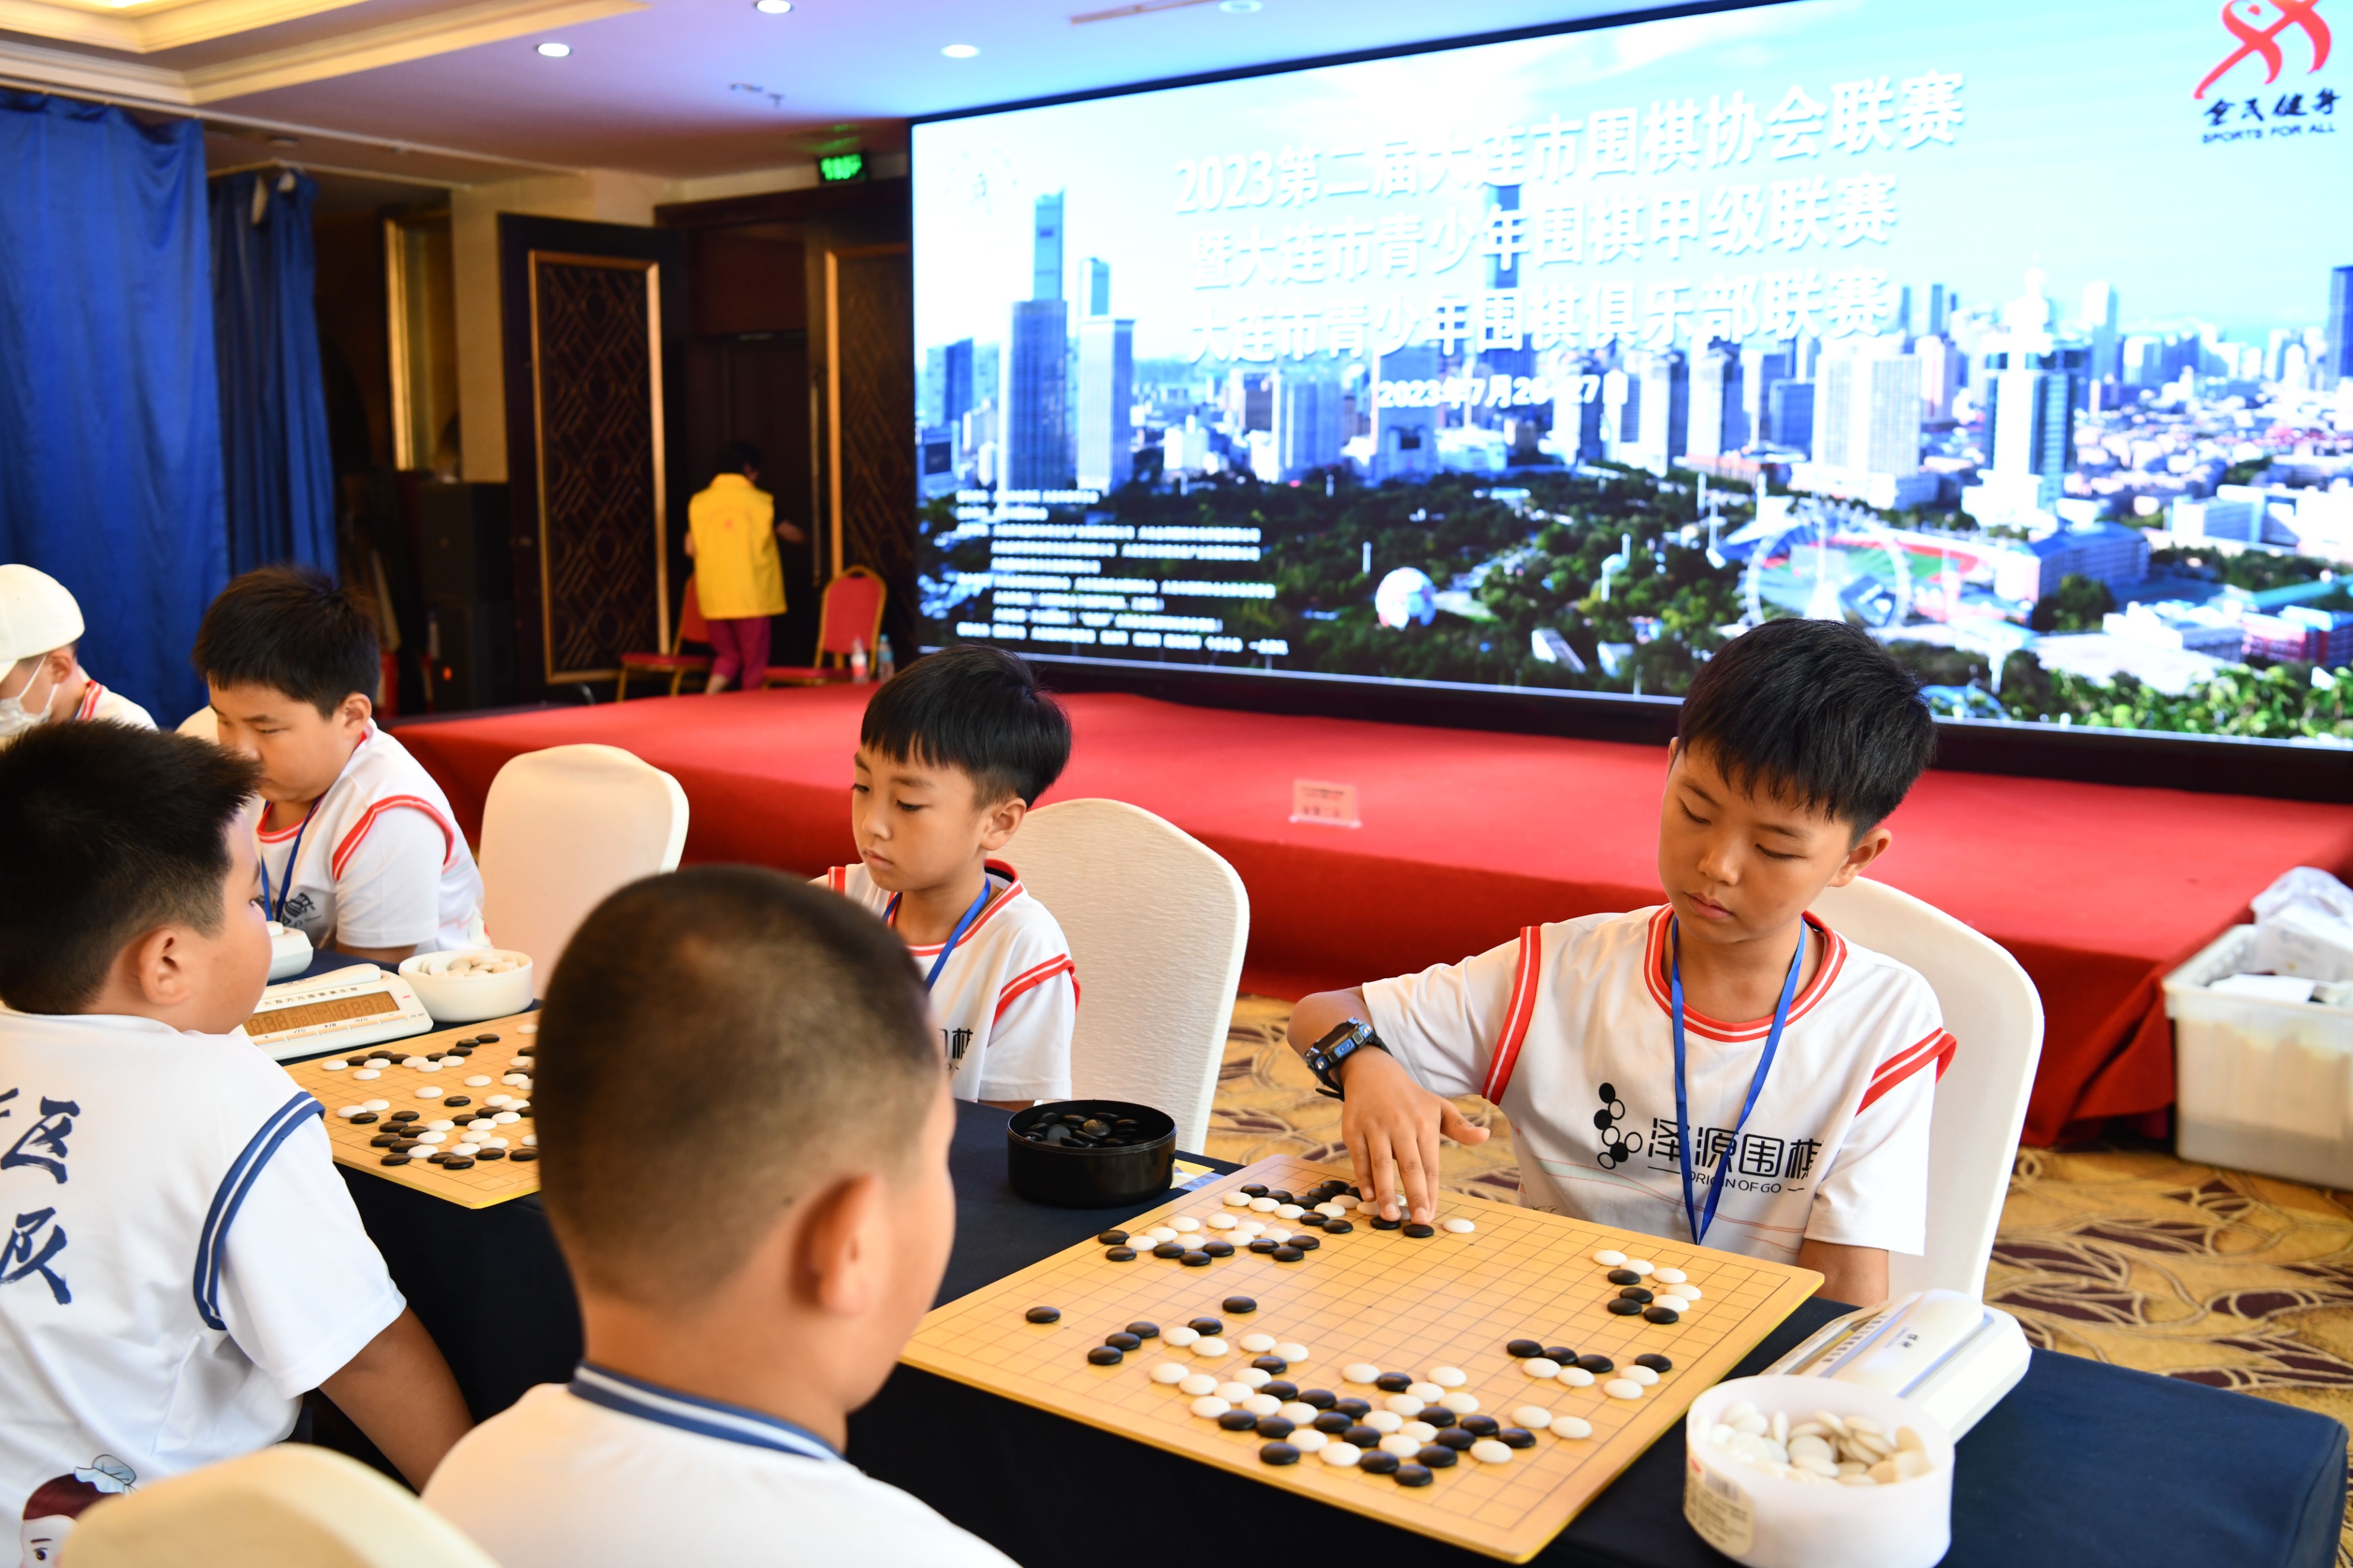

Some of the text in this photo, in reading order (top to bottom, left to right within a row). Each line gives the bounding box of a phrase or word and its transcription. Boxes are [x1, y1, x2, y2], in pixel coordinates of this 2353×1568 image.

[1174, 69, 1964, 215] 2023第二届大连市围棋协会联赛
[2271, 124, 2303, 137] FOR
[2308, 122, 2336, 133] ALL
[1192, 169, 1898, 290] 暨大连市青少年围棋甲级联赛
[1189, 265, 1890, 364] 大连市青少年围棋俱乐部联赛
